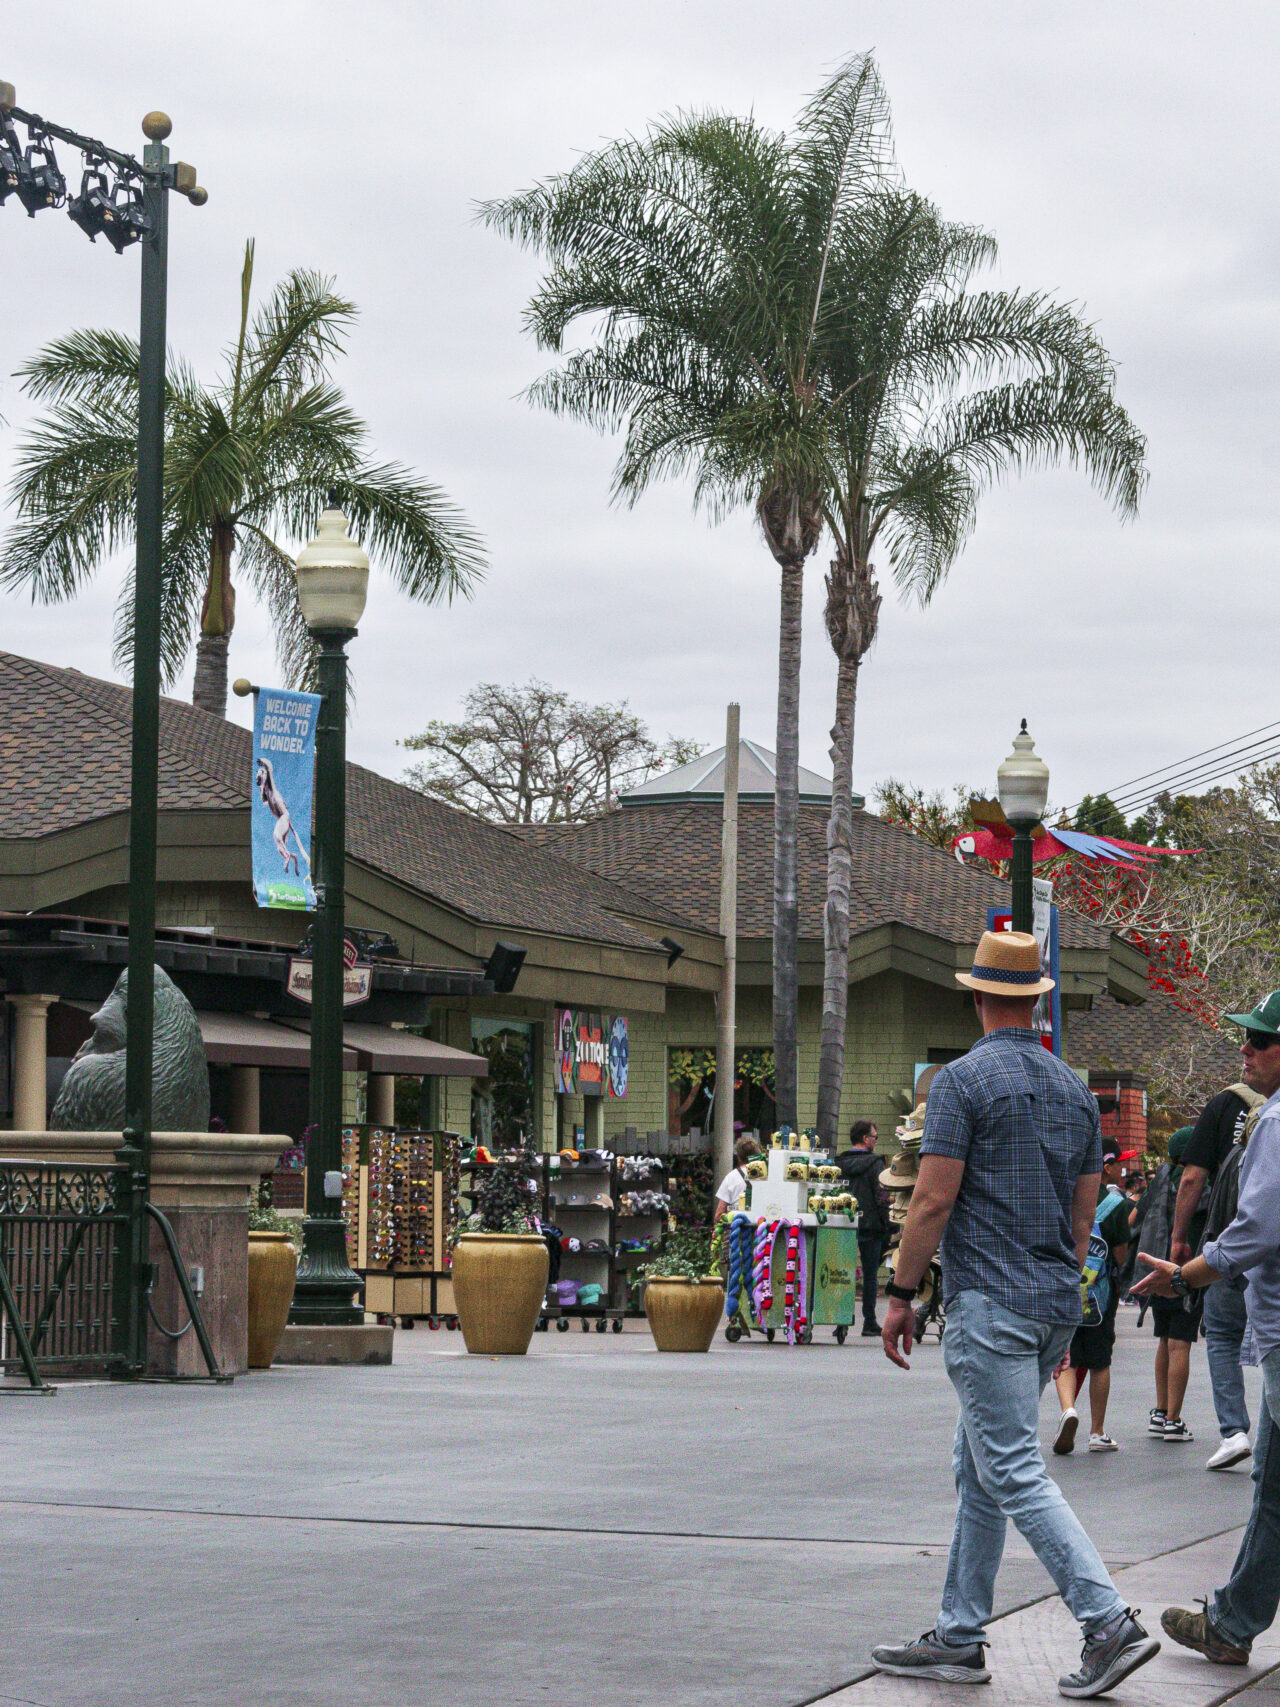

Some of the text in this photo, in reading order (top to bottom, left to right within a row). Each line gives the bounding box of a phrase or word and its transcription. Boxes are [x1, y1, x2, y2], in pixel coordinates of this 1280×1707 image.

[266, 698, 313, 718] WELCOME
[263, 714, 309, 737] BACK TO
[260, 732, 306, 754] WONDER.
[1088, 1240, 1106, 1258] ILO
